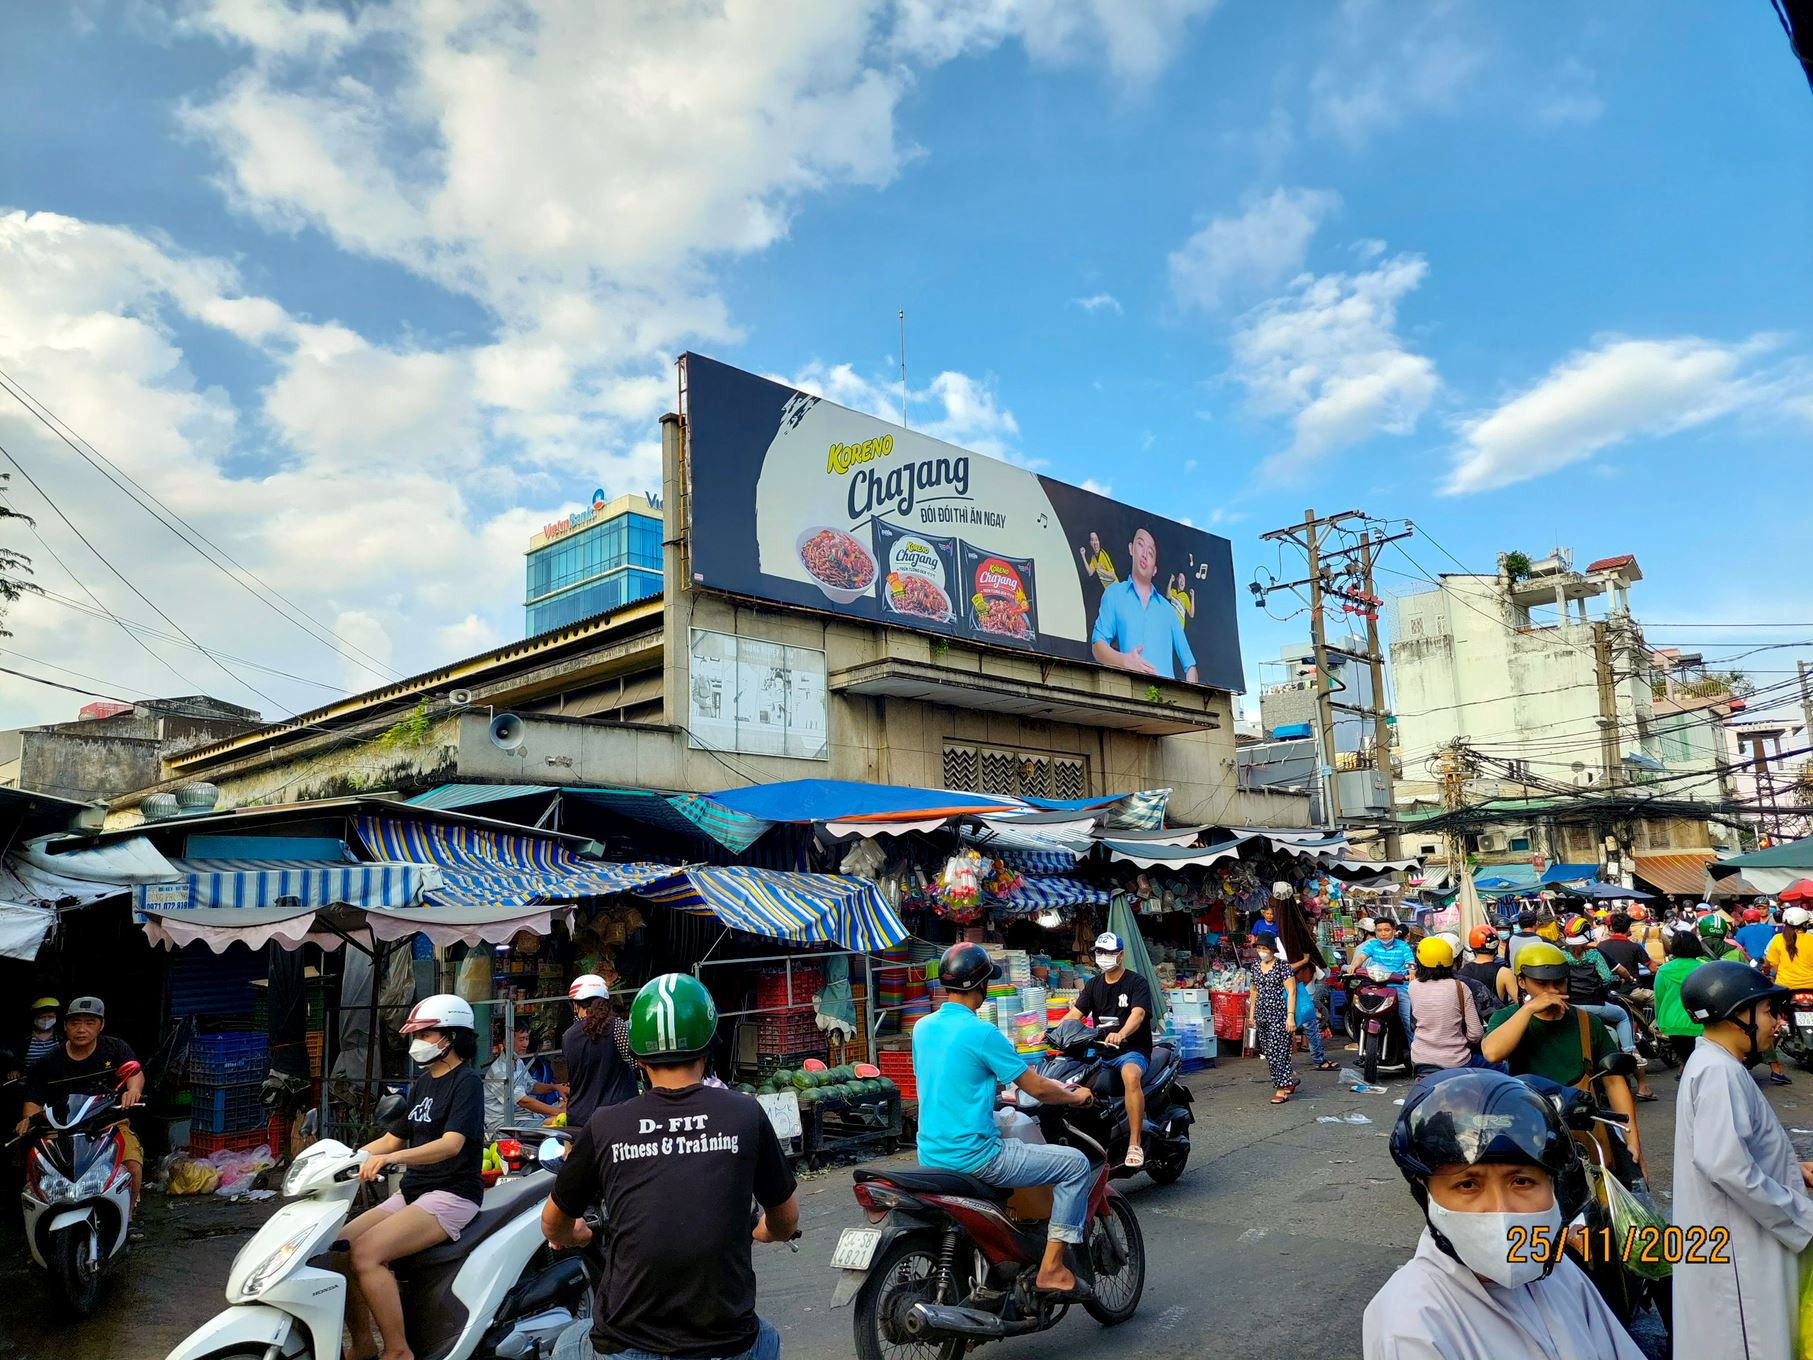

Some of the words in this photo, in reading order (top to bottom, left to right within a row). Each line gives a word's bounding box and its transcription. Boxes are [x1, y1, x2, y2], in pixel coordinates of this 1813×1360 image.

[826, 433, 894, 475] KORENO
[920, 504, 937, 523] ĐÓI
[937, 504, 953, 523] ĐÓI
[970, 506, 982, 525] ĂN
[984, 511, 1006, 529] NGAY
[1709, 927, 1723, 935] Grab
[668, 1114, 709, 1133] FIT
[611, 1140, 659, 1164] Fitness
[661, 1137, 673, 1154] &
[676, 1132, 739, 1154] Training
[312, 1284, 339, 1297] HONDA
